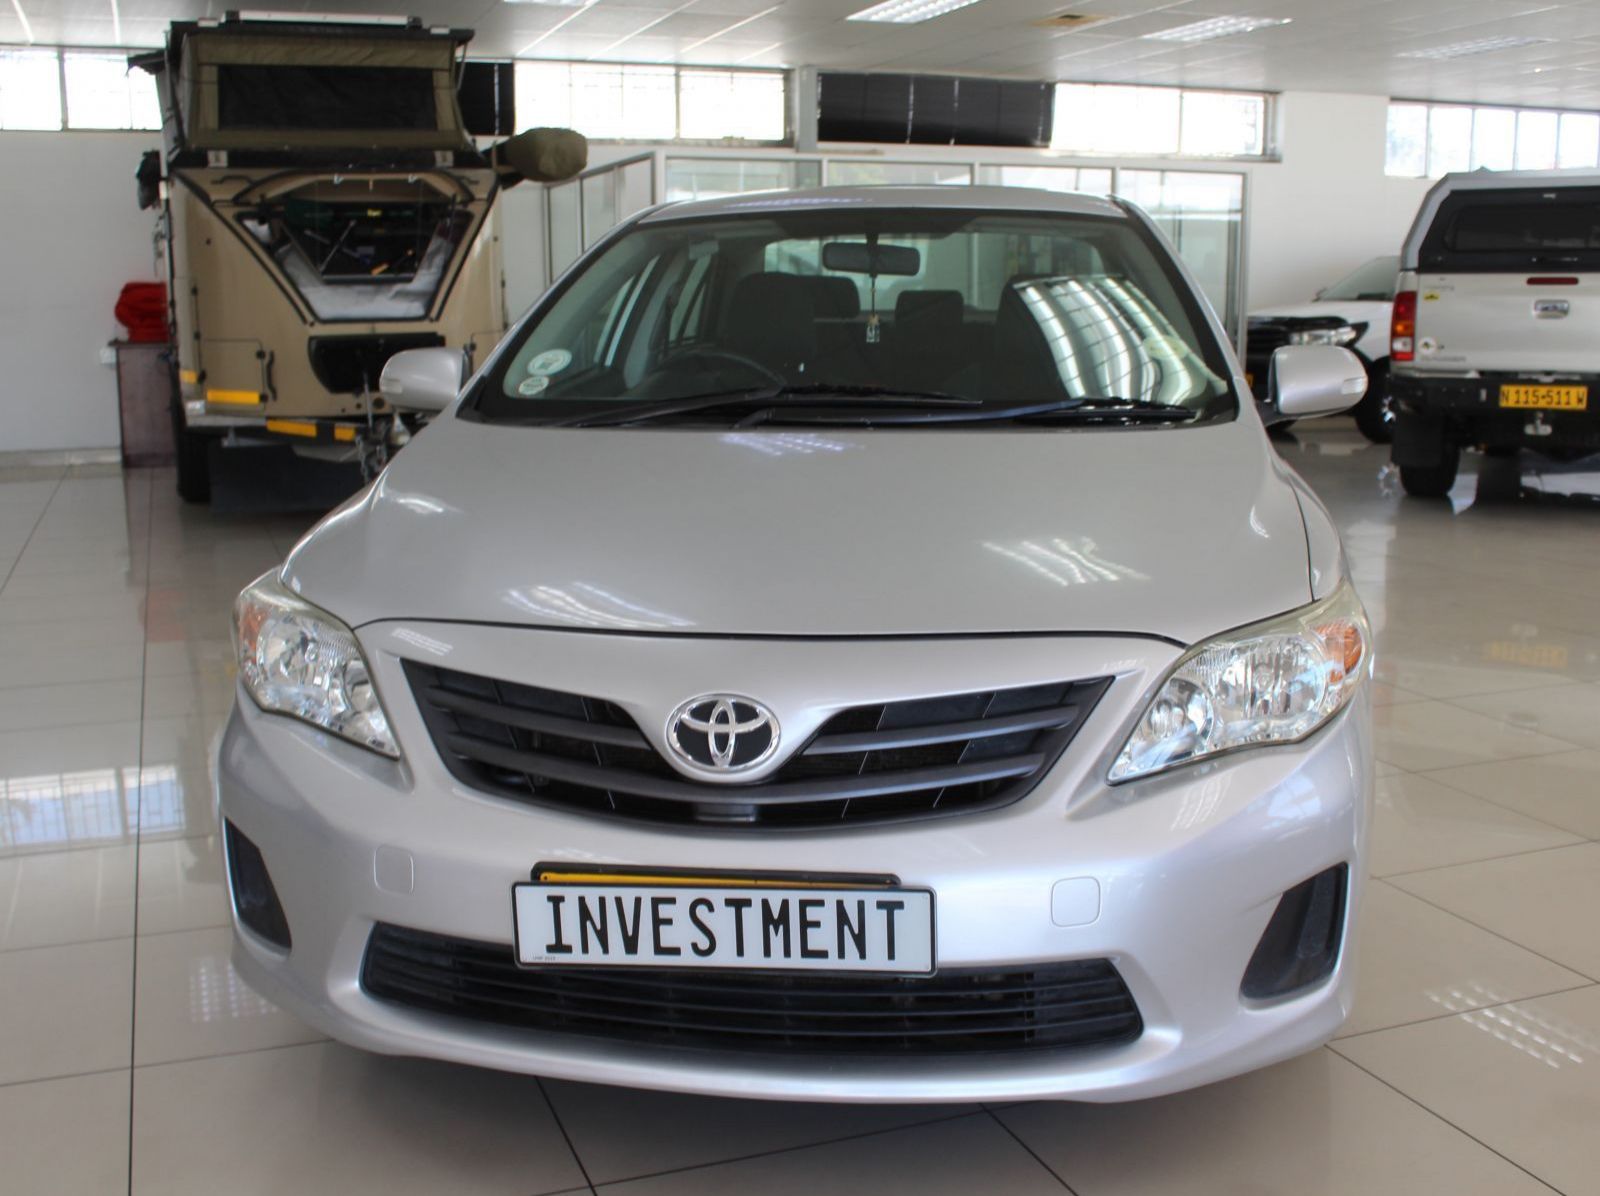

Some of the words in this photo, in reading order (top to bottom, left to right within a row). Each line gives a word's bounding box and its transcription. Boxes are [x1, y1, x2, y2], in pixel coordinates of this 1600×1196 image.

[1501, 390, 1509, 404] N
[1514, 390, 1571, 405] 115-511
[1576, 391, 1584, 405] W
[546, 895, 905, 960] INVESTMENT
